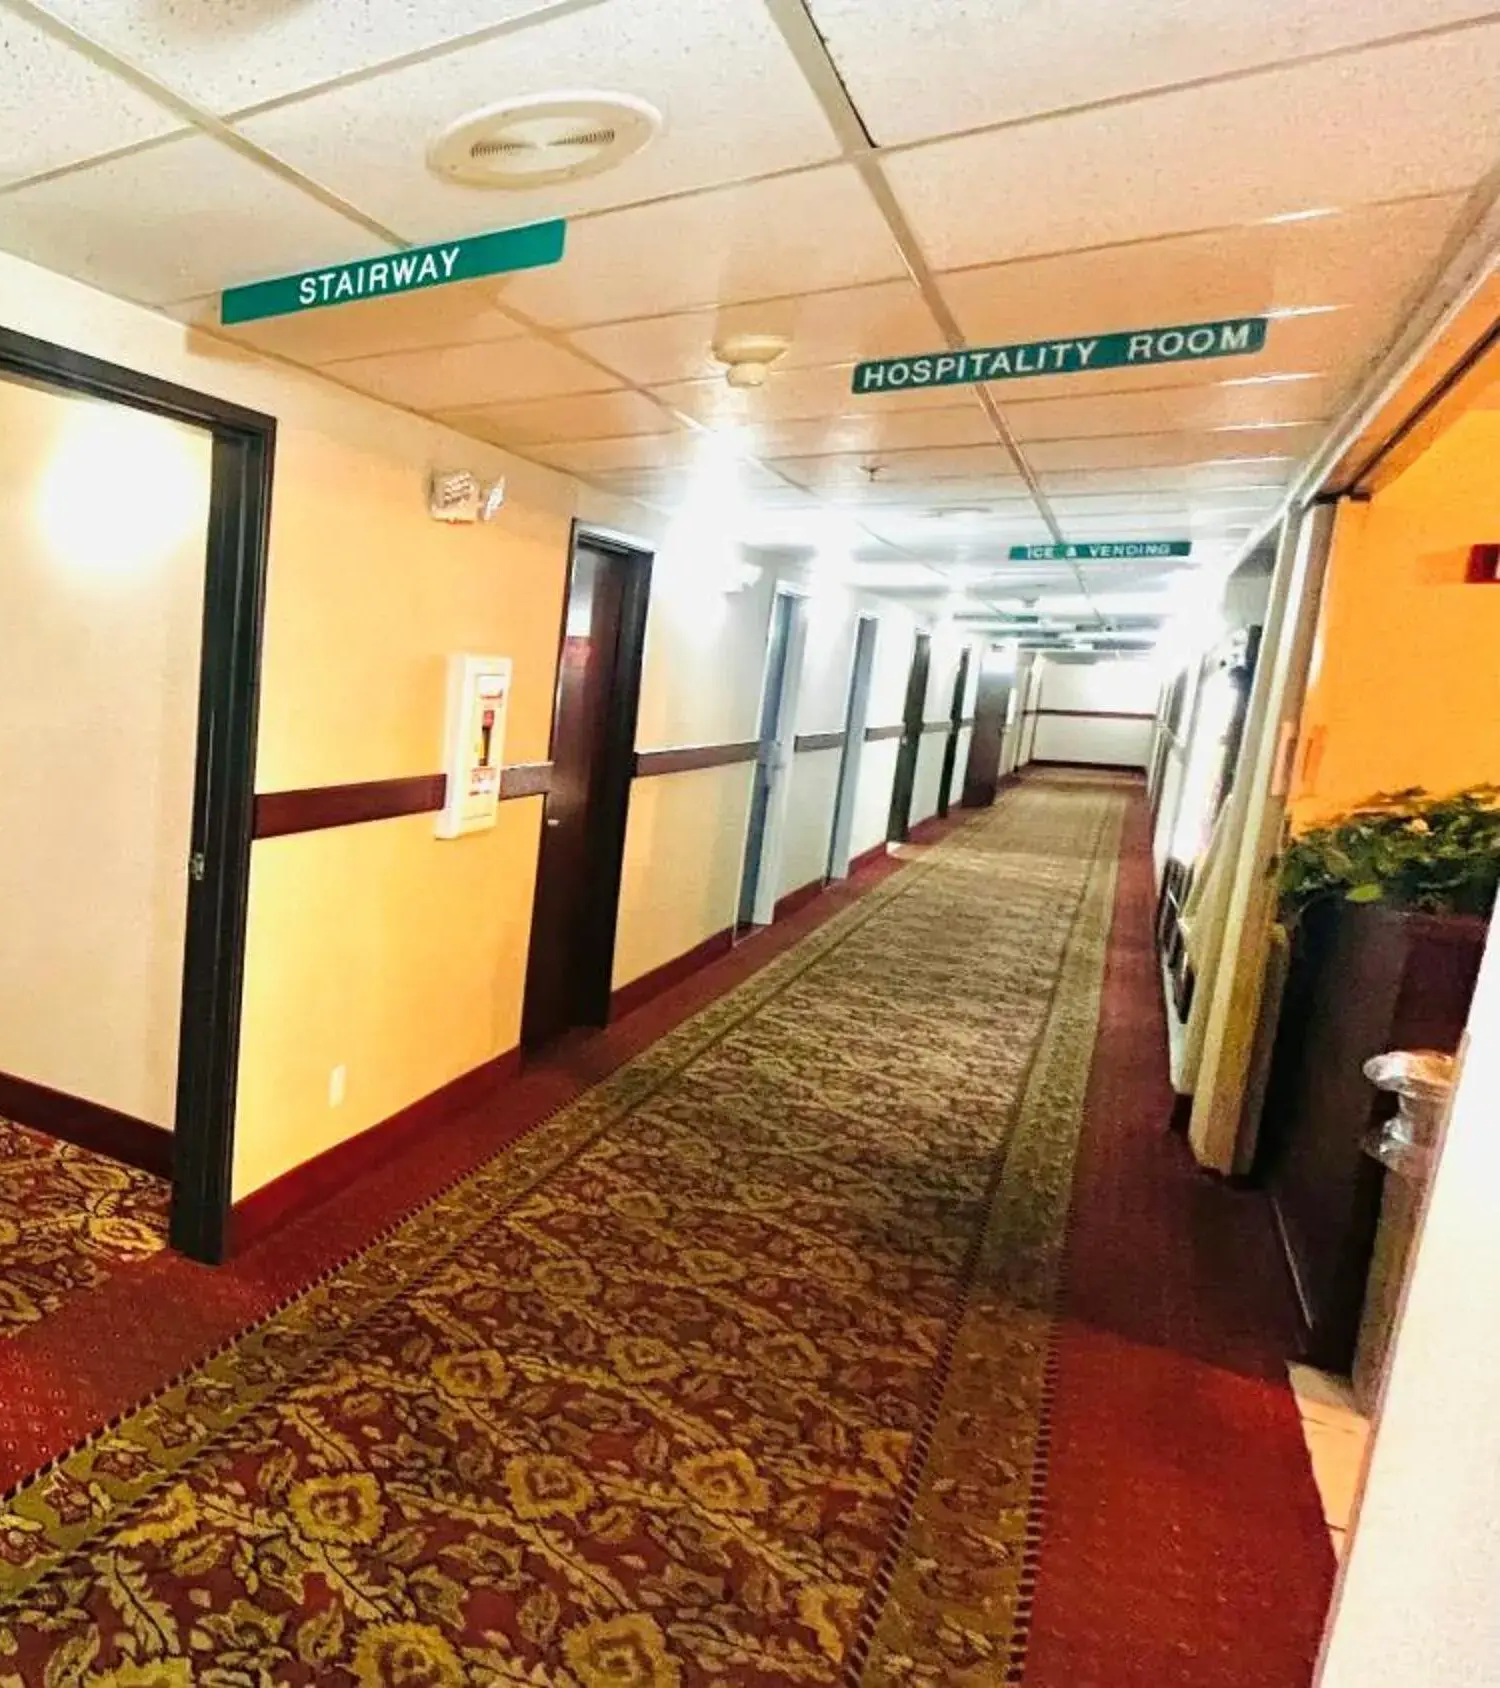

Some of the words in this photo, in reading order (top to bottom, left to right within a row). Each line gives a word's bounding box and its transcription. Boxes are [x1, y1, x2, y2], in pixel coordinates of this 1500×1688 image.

[299, 247, 460, 304] STAIRWAY
[863, 340, 1100, 389] HOSPITALITY
[1127, 323, 1251, 360] ROOM
[1027, 545, 1054, 559] ICE
[1089, 544, 1172, 558] VENDING
